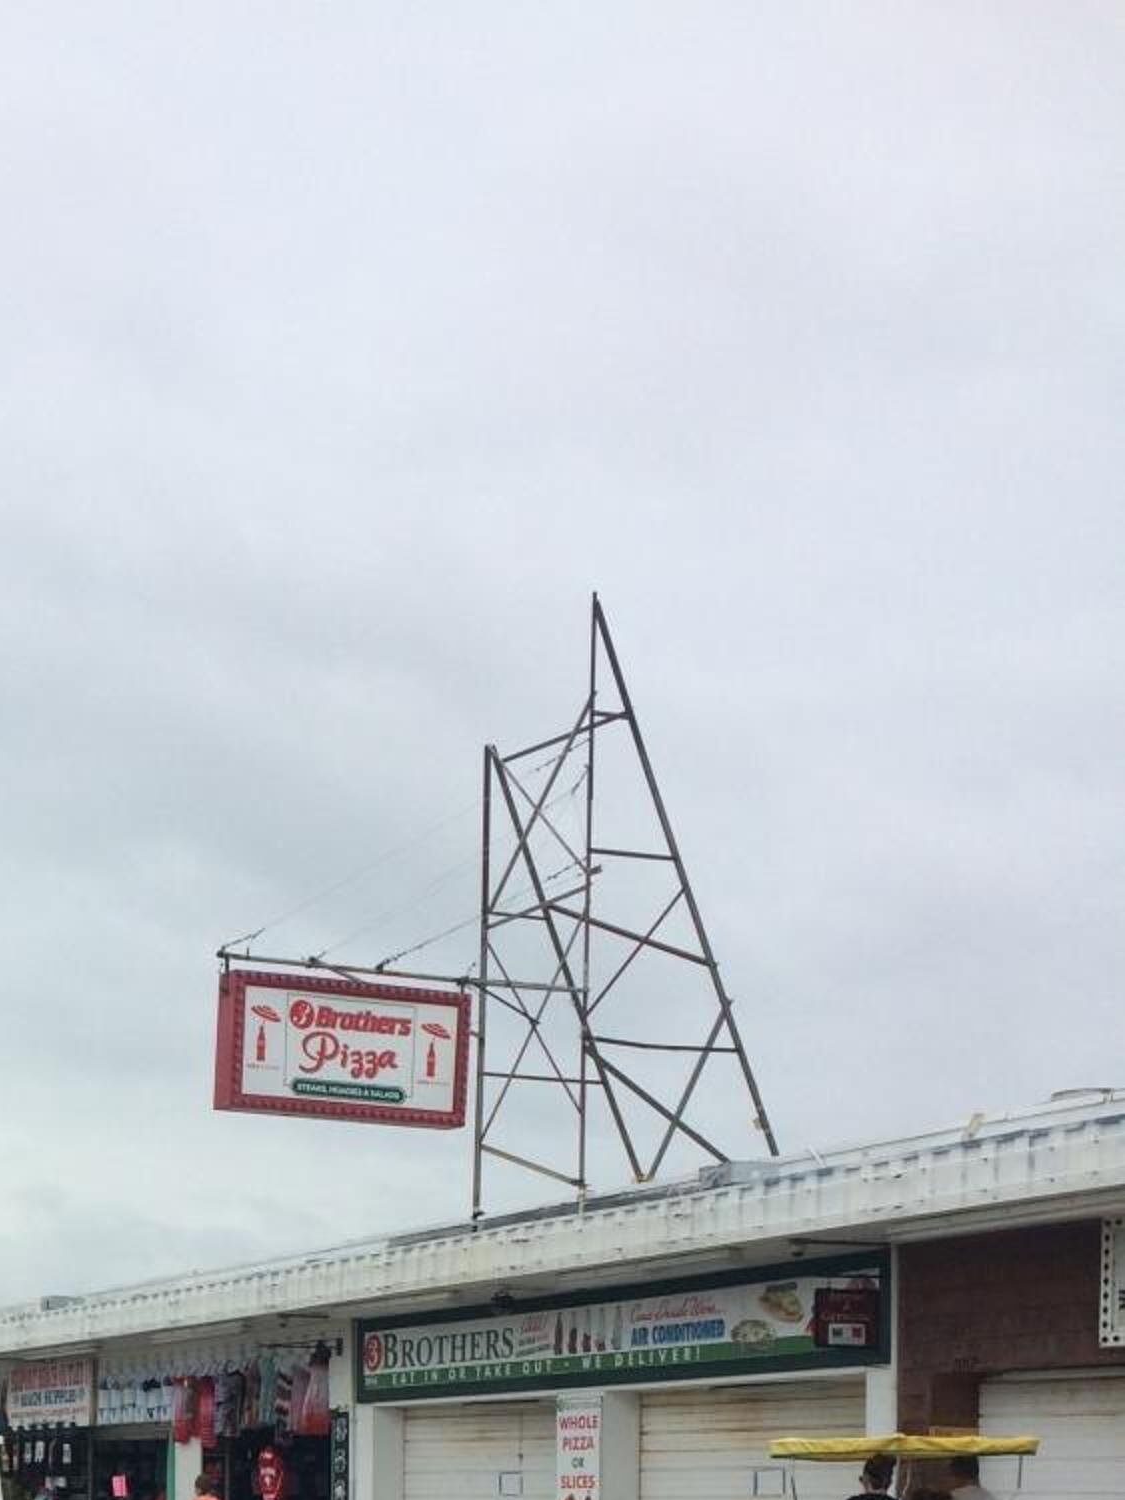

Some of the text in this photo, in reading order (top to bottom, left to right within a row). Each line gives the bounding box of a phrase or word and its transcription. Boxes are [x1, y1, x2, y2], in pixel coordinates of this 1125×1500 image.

[315, 1006, 412, 1037] Brothers
[299, 1031, 399, 1079] Pizza
[631, 1318, 725, 1346] AIR CONDITIONED
[382, 1327, 515, 1369] BROTHERS
[392, 1371, 414, 1385] EAT
[426, 1369, 438, 1383] IN
[449, 1366, 466, 1381] OR
[477, 1362, 511, 1379] TAKE
[523, 1359, 552, 1374] OUT
[582, 1354, 602, 1369] WE
[615, 1347, 700, 1366] DELIVER!
[558, 1416, 598, 1430] WHOLE
[562, 1437, 595, 1451] PIZZA
[560, 1475, 595, 1489] SLICES
